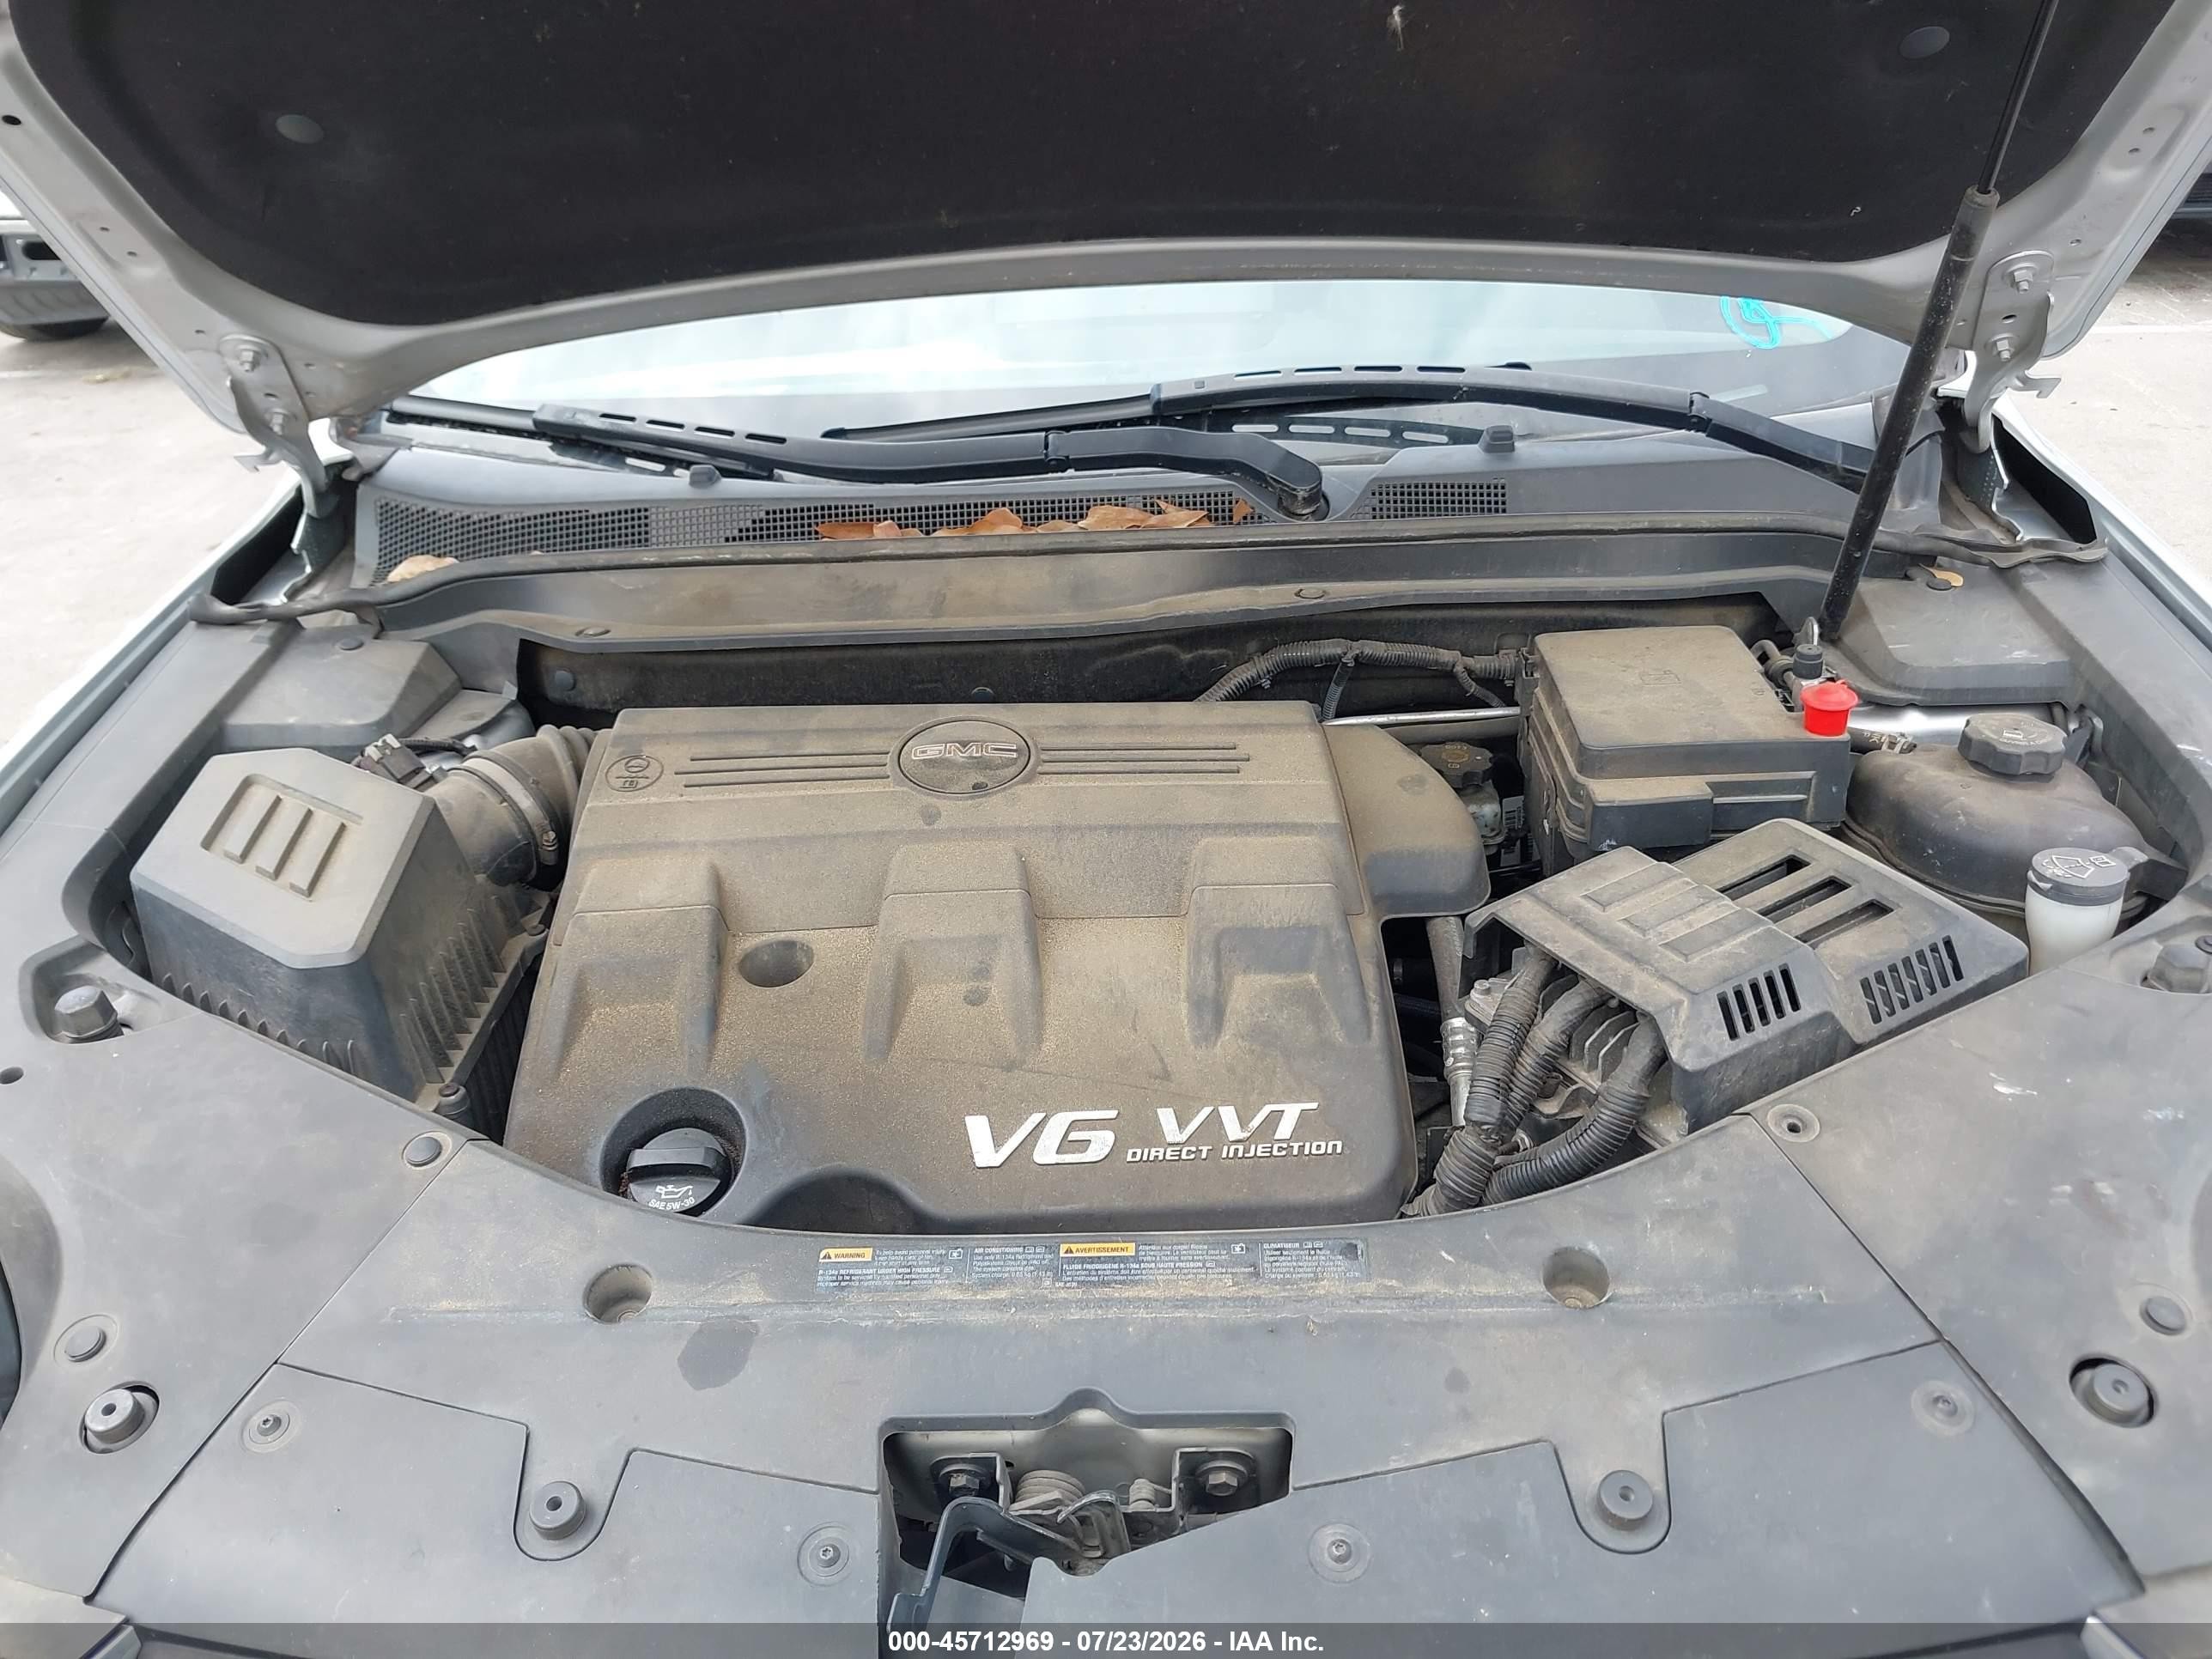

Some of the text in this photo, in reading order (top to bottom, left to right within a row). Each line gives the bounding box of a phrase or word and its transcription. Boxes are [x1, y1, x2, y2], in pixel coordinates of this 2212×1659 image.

[912, 742, 1018, 760] GMC
[964, 1102, 1319, 1169] V6 VVT
[1126, 1139, 1343, 1163] DIRECT INJECTION
[648, 1196, 695, 1211] SAE 5W-30
